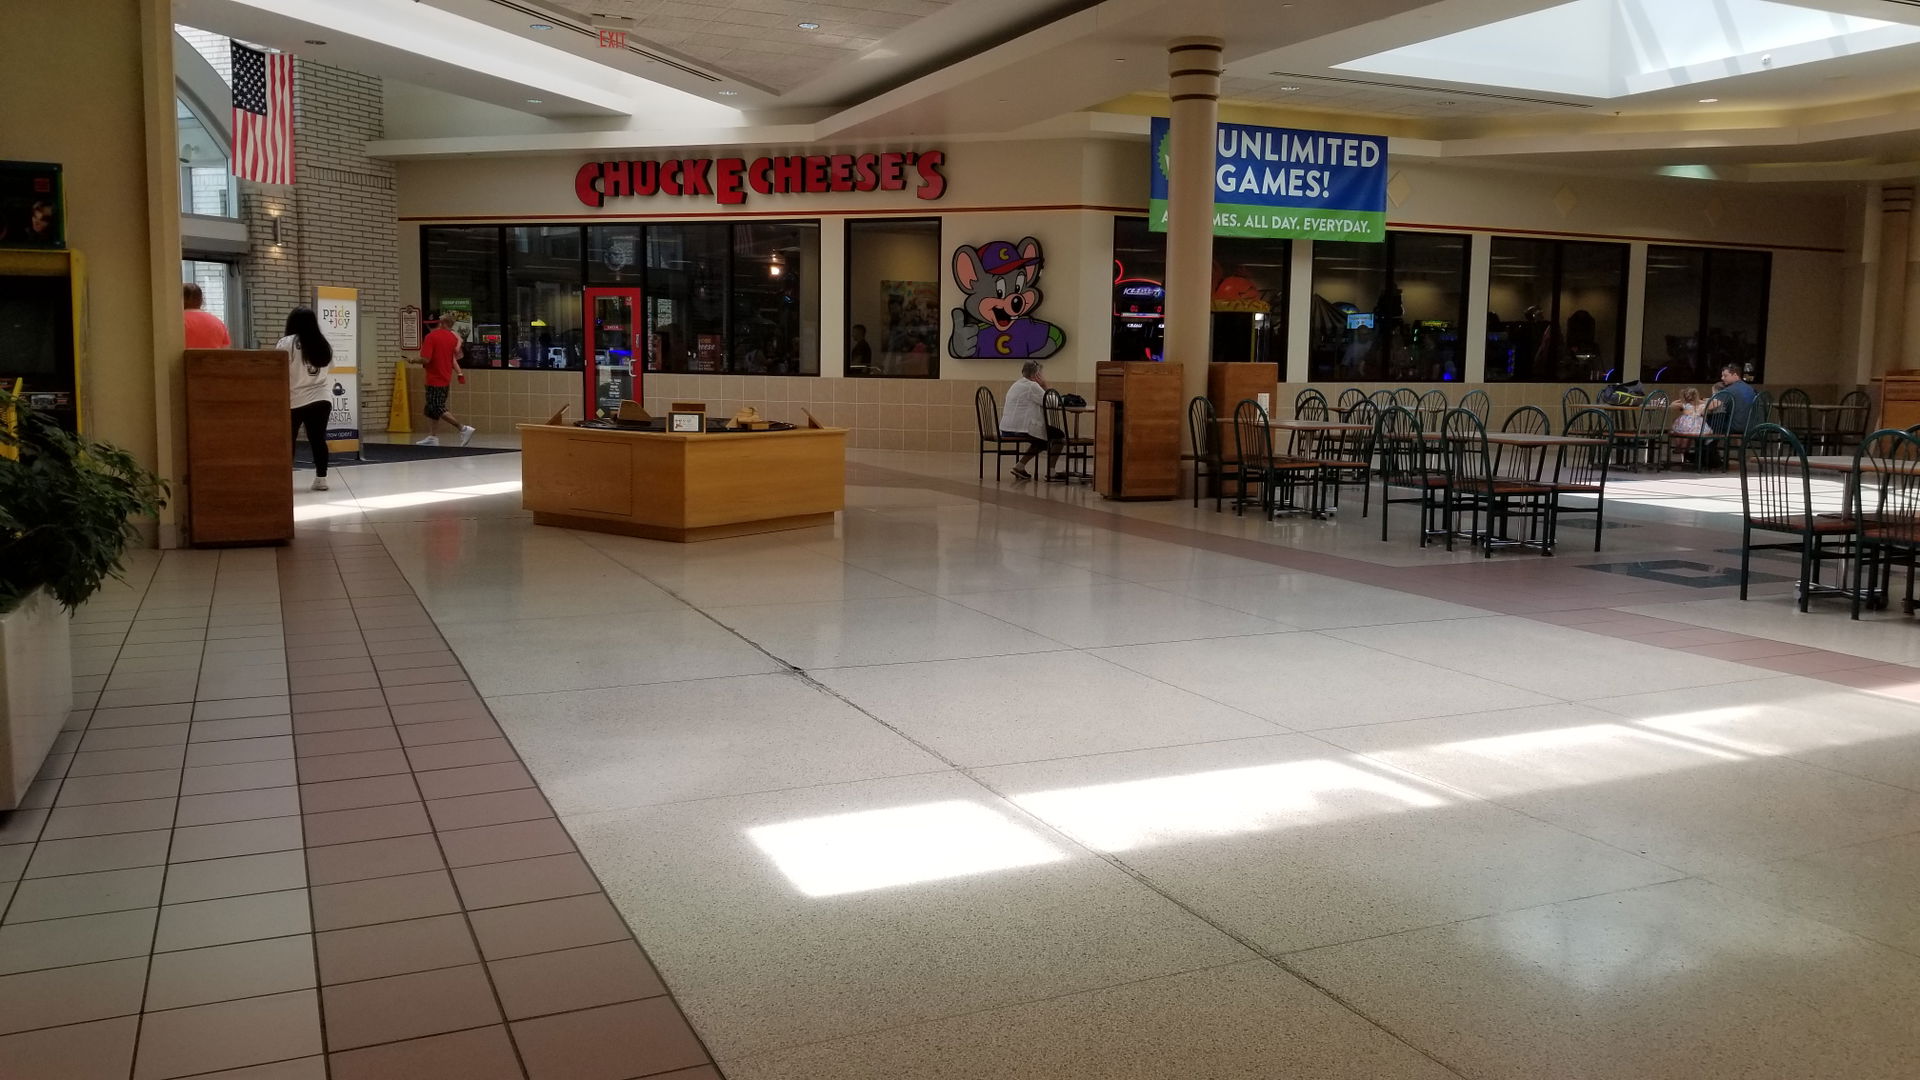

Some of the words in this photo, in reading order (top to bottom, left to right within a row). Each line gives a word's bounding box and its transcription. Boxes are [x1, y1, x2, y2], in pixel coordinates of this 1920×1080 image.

[599, 30, 626, 48] EXIT
[1217, 128, 1380, 168] UNLIMITED
[575, 159, 713, 207] CHUCK
[716, 158, 748, 205] E
[750, 150, 947, 200] CHEESE'S
[1216, 164, 1331, 199] GAMES!
[1213, 213, 1241, 227] MES.
[1244, 214, 1268, 229] ALL
[1271, 215, 1300, 230] DAY.
[1303, 217, 1371, 234] EVERYDAY.
[323, 305, 351, 320] pride
[995, 334, 1013, 356] C
[332, 397, 350, 412] LUE
[328, 411, 353, 423] ARISTA
